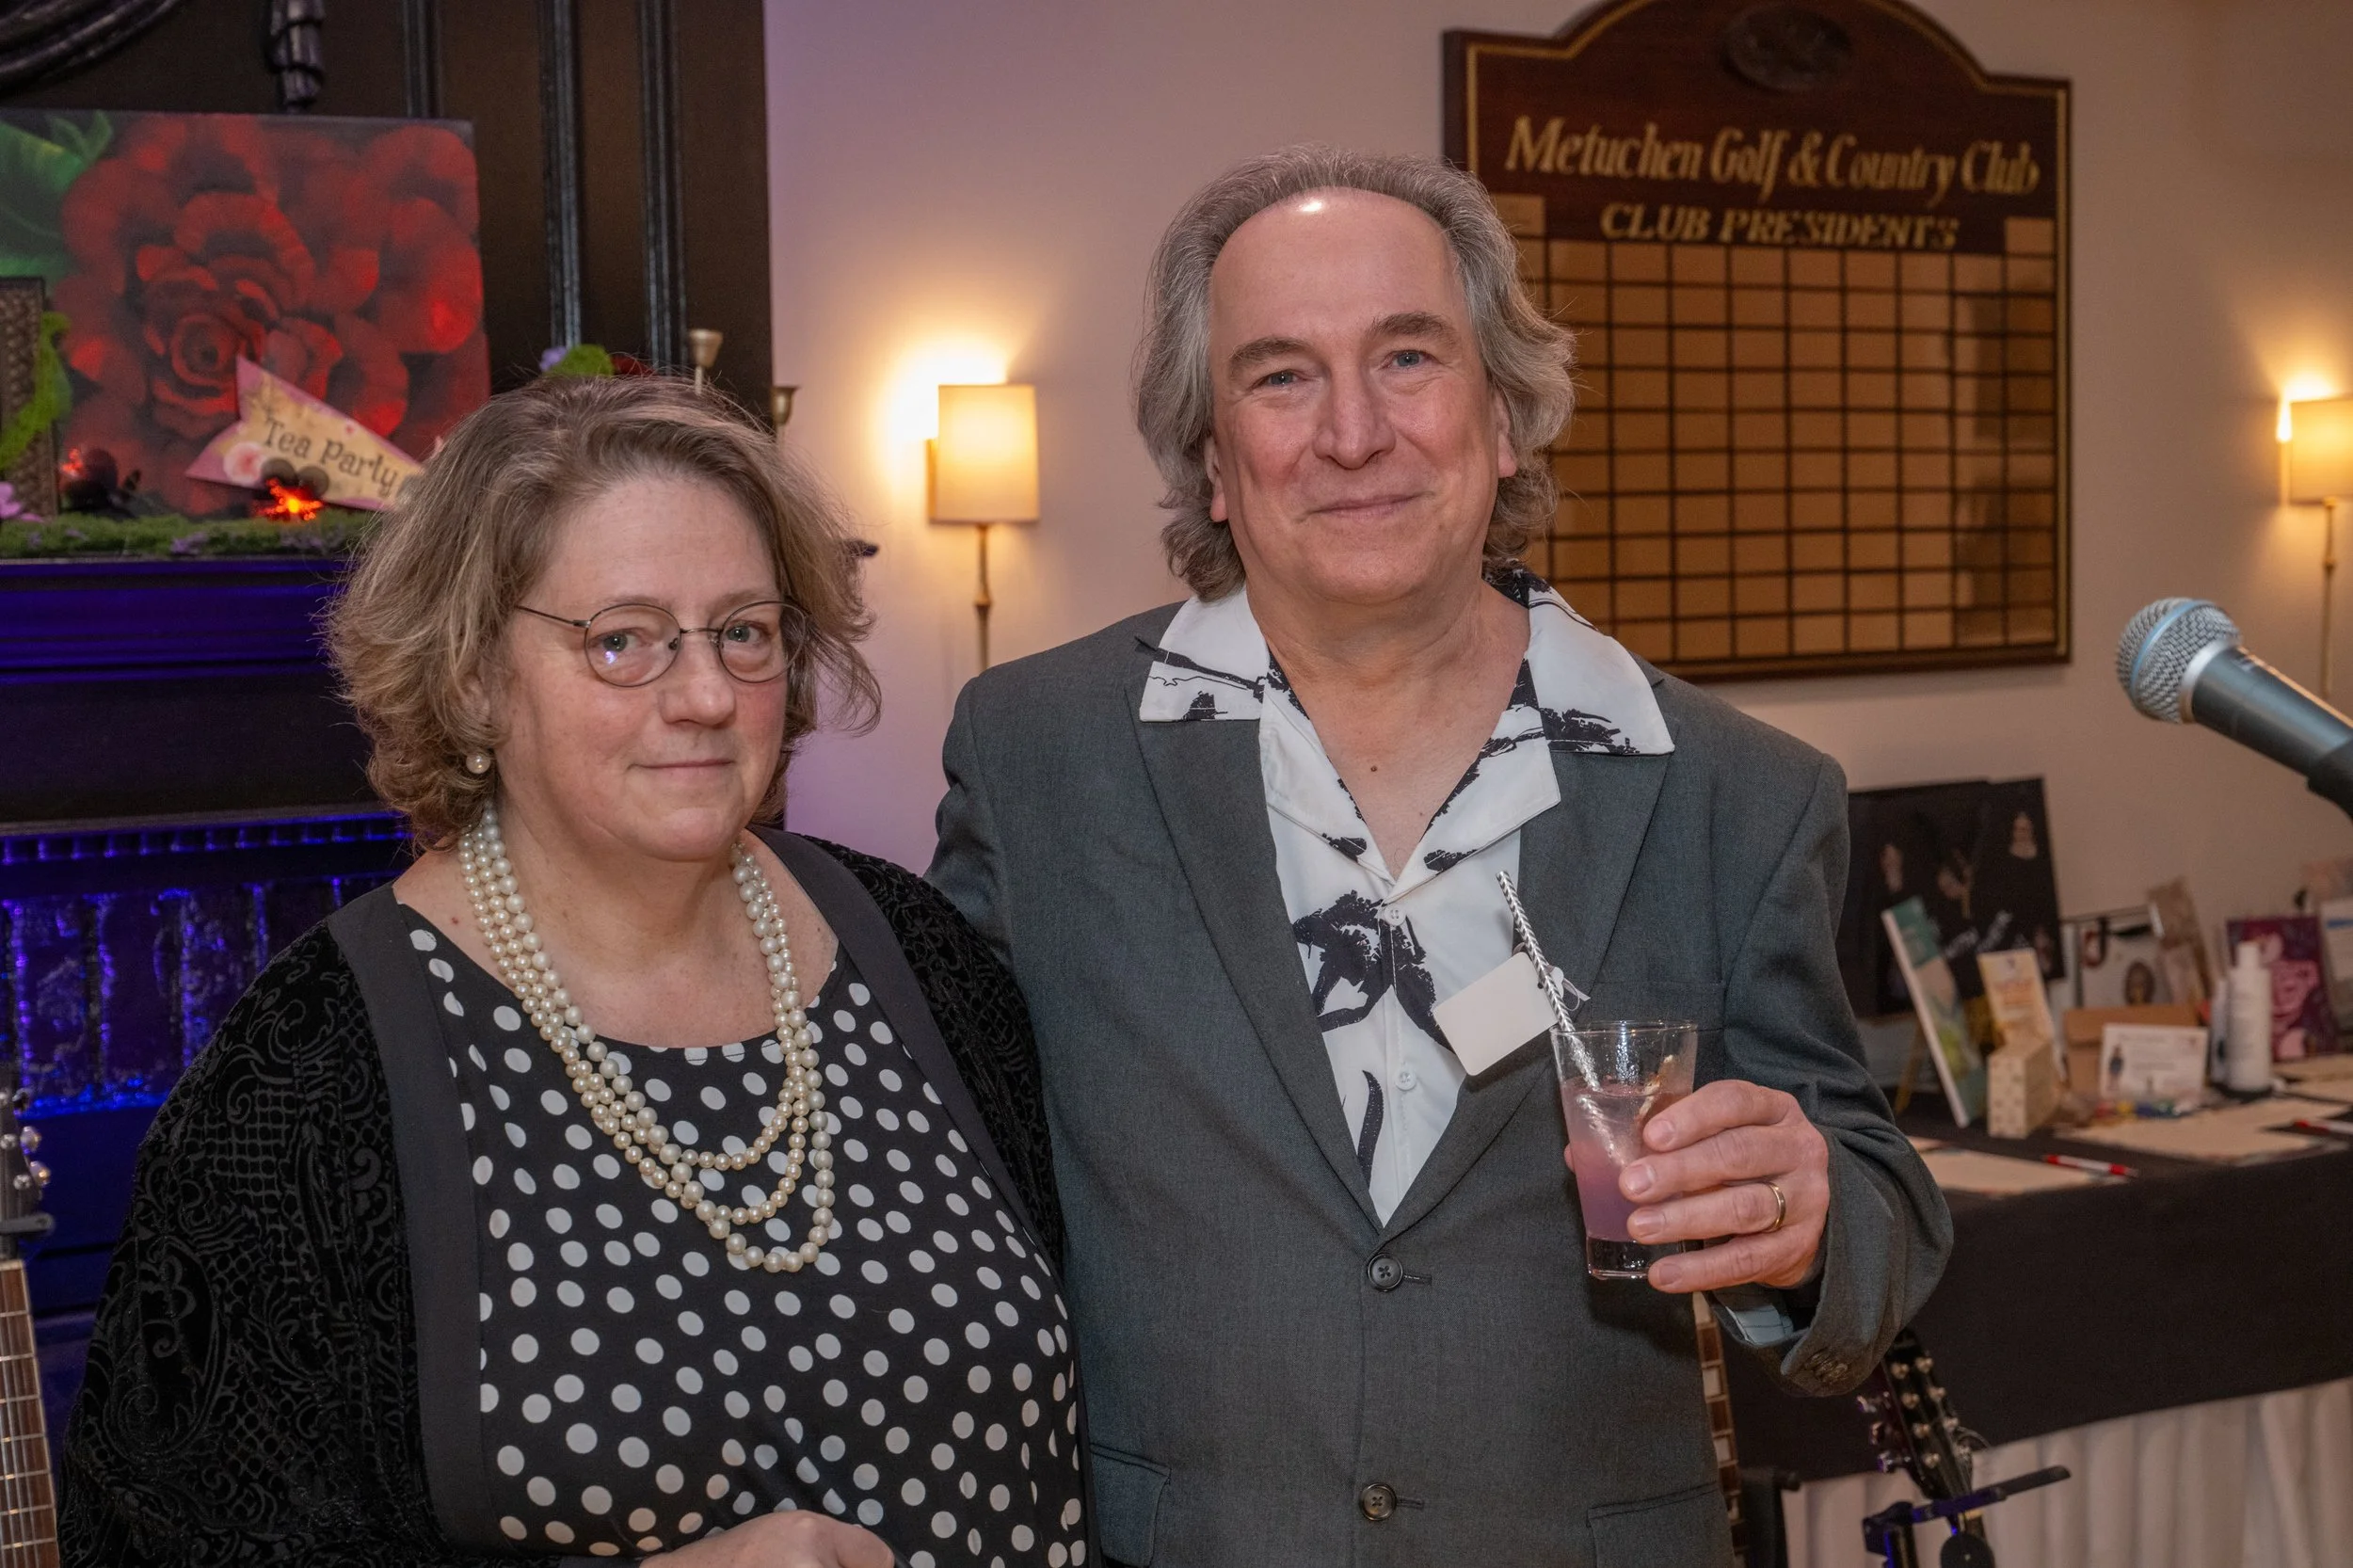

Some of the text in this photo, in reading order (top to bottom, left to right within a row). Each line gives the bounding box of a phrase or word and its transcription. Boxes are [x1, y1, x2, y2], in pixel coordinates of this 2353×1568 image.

[1504, 114, 2041, 208] Metuchen Golf & Country Club
[1601, 201, 1960, 249] CLUB PRESIDENTS
[262, 417, 398, 498] Tea Party
